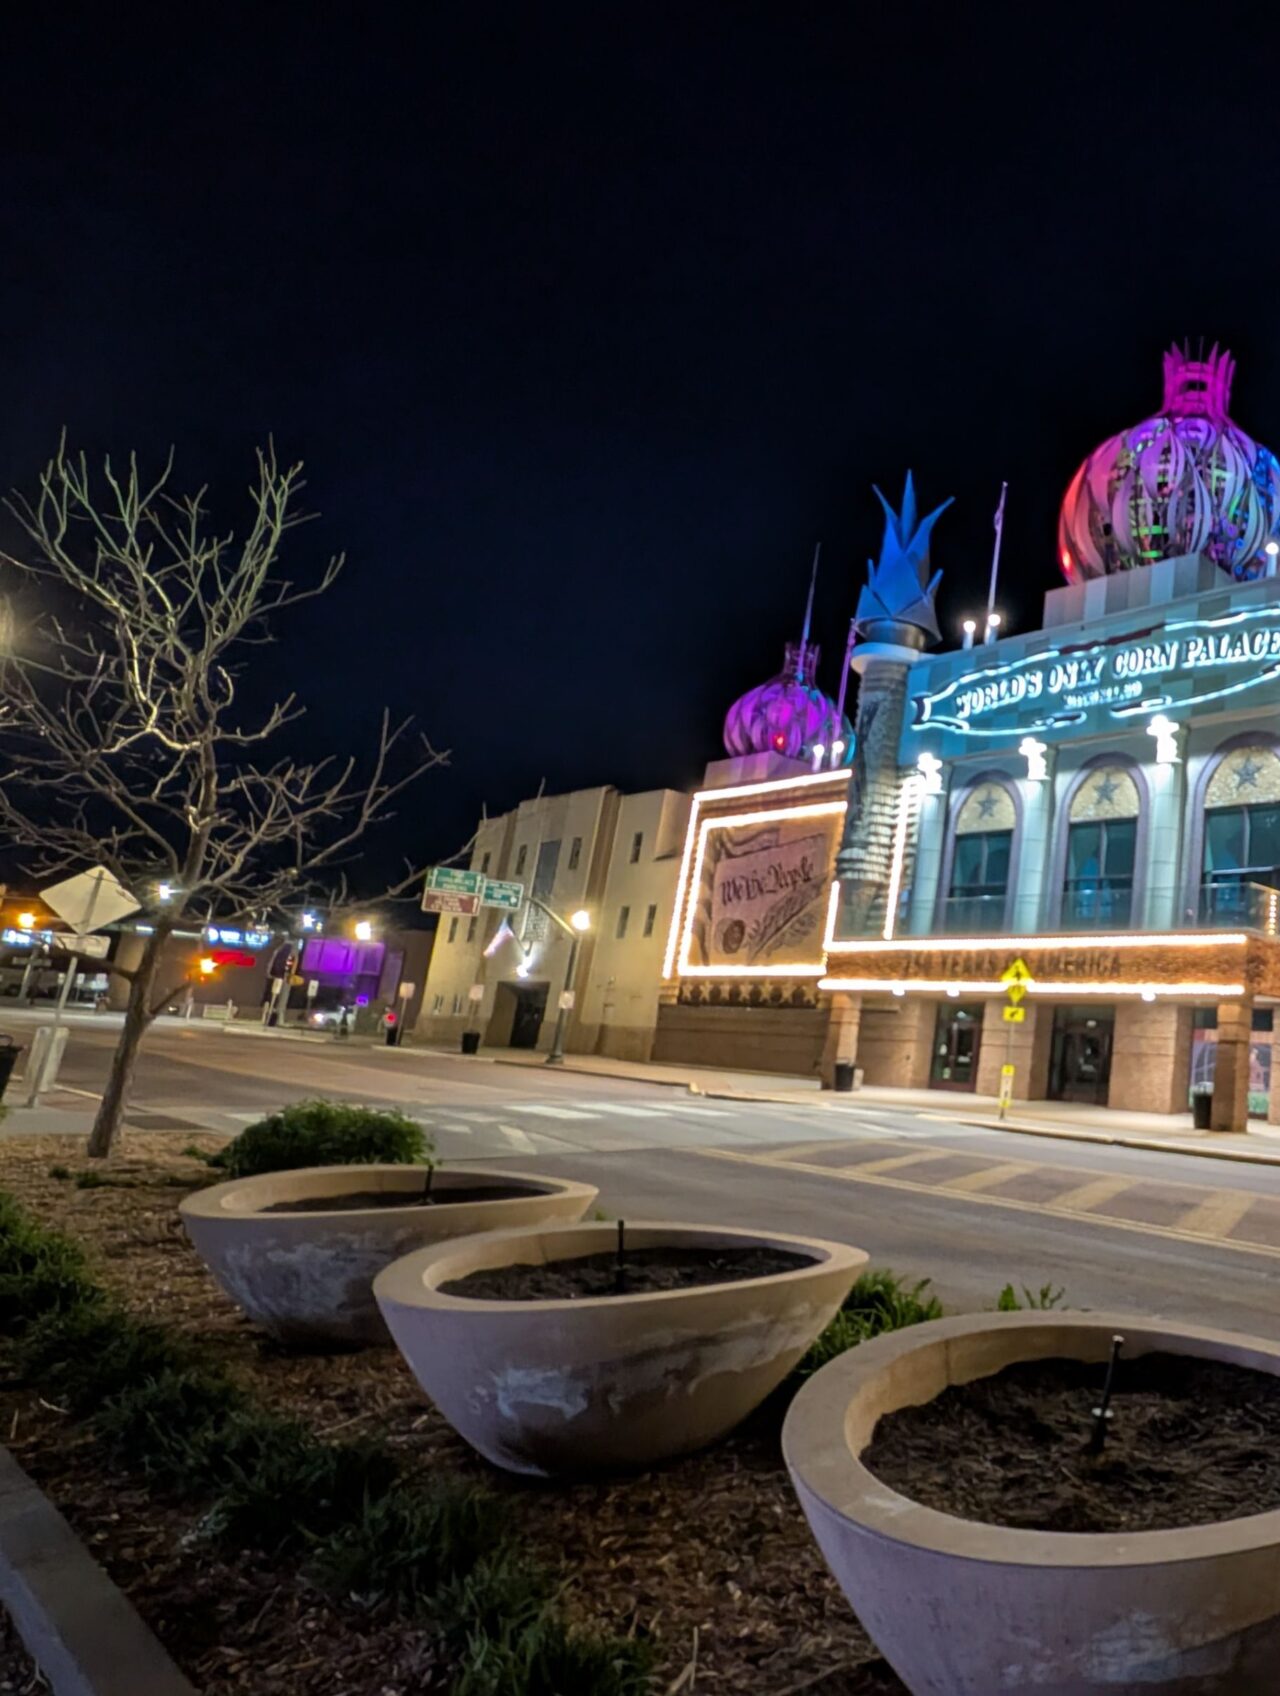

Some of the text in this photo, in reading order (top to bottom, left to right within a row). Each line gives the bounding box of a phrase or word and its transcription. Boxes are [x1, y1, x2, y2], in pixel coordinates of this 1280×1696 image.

[956, 671, 1043, 717] WORLD'S
[1047, 656, 1106, 694] ONLY
[1111, 641, 1179, 678] CORN
[1035, 949, 1121, 979] AMERICA
